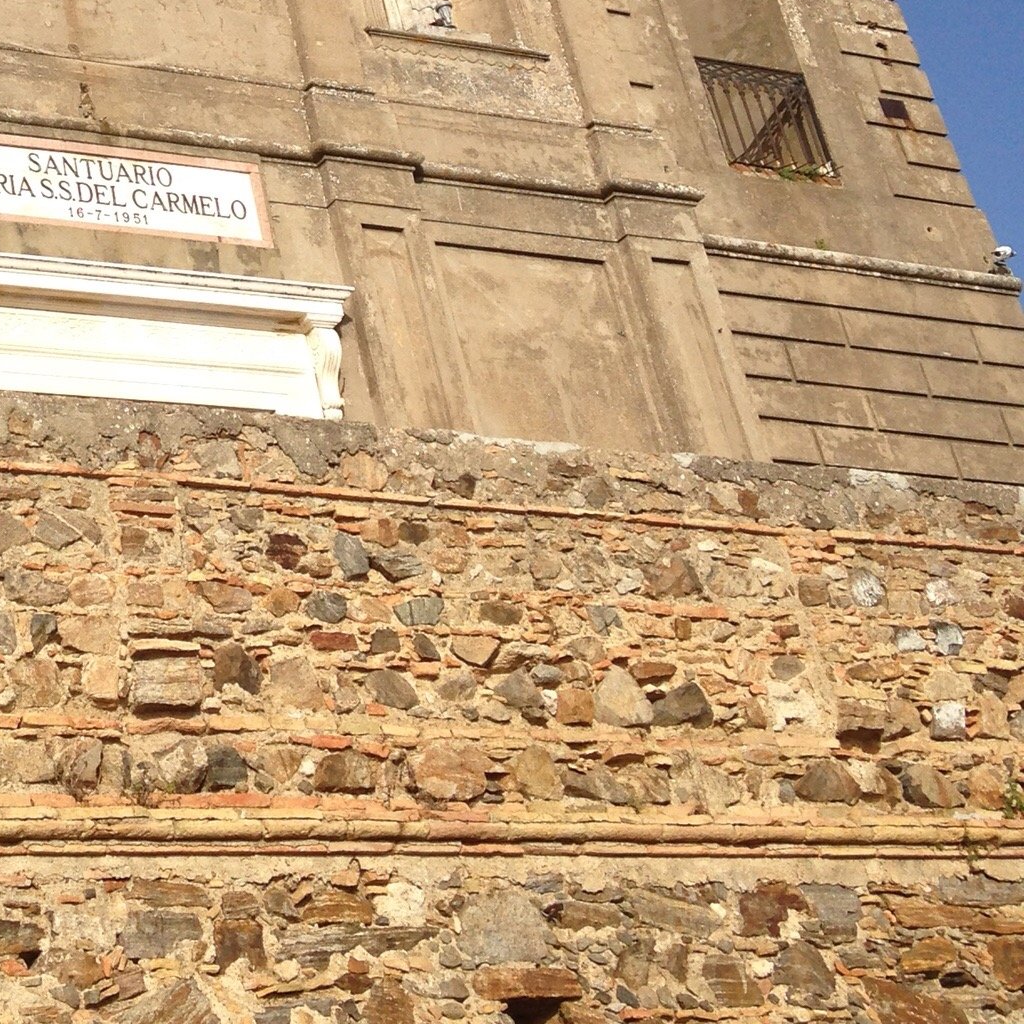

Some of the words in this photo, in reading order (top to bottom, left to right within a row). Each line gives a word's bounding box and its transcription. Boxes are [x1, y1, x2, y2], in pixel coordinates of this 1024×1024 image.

[28, 152, 173, 188] SANTUARIO
[68, 207, 149, 225] 16-7-1951
[131, 188, 247, 220] CARMELO
